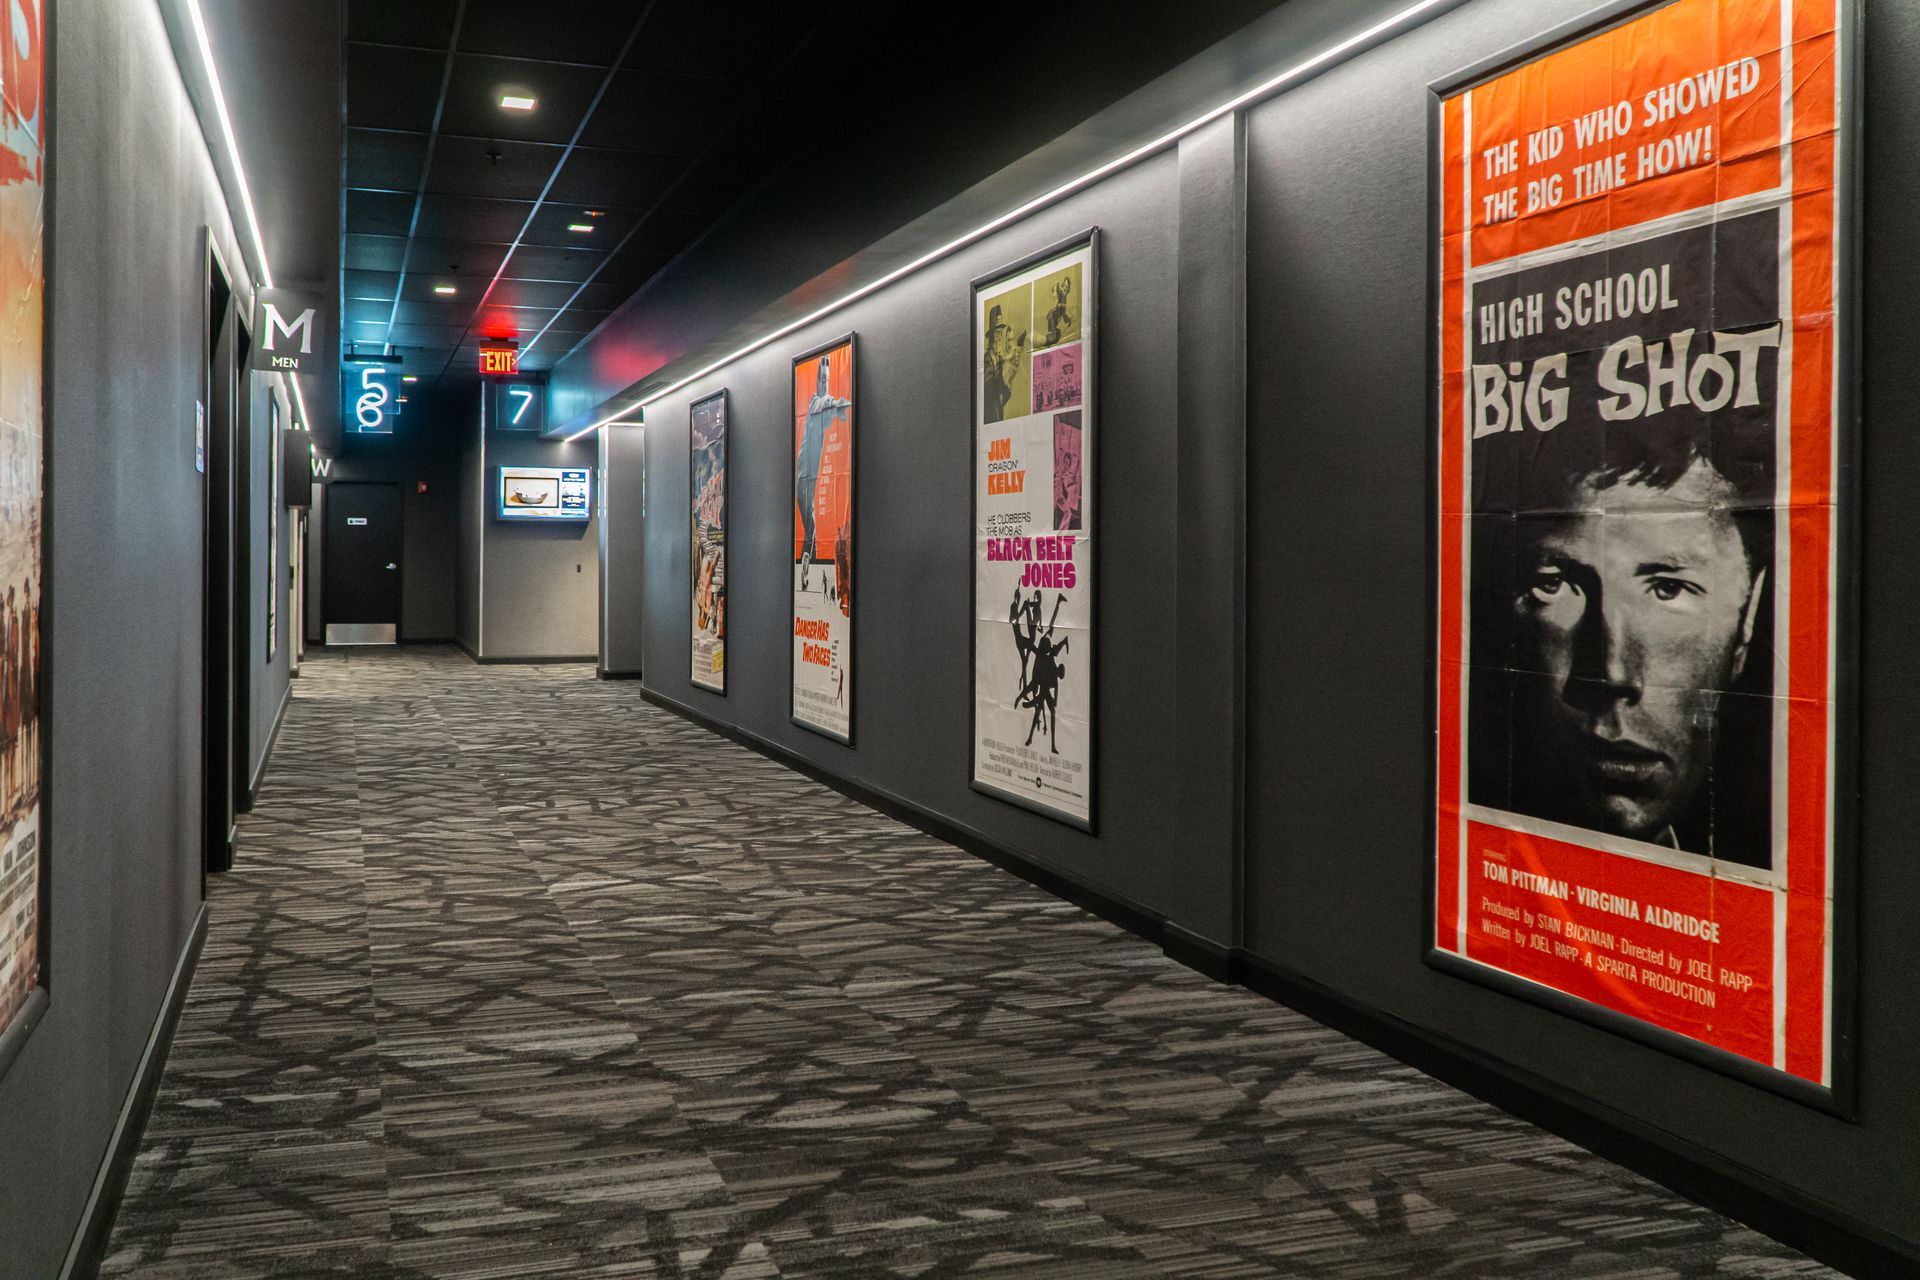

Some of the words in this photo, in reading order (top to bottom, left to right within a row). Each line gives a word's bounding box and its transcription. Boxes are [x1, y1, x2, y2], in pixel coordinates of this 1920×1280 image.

[1484, 140, 1518, 180] THE
[1528, 126, 1563, 166] KID
[1574, 101, 1632, 149] WHO
[1643, 56, 1760, 127] SHOWED
[1483, 186, 1518, 225] THE
[1528, 174, 1563, 213] BIG
[1573, 152, 1626, 199] TIME
[1638, 125, 1712, 181] HOW!
[1481, 293, 1543, 345] HIGH
[1556, 264, 1678, 330] SCHOOL
[262, 303, 316, 353] M
[272, 356, 298, 368] MEN
[486, 352, 513, 372] EXIT
[362, 368, 388, 407] 5
[356, 392, 382, 427] 6
[509, 390, 533, 424] 7
[988, 438, 1010, 461] JIM
[311, 458, 333, 477] W
[988, 470, 1025, 495] KELLY
[987, 527, 997, 536] THE
[999, 526, 1013, 536] MOB
[1014, 526, 1022, 535] AS
[988, 515, 996, 525] HE
[998, 512, 1031, 524] CLOBBERS
[988, 537, 1032, 561] BLACK
[1036, 536, 1075, 560] BELT
[1022, 563, 1076, 588] JONES
[1483, 861, 1508, 884] TOM
[1512, 869, 1568, 901] PITTMAN
[1576, 885, 1639, 920] VIRGINIA
[1645, 905, 1720, 944] ALDRIDGE
[1482, 896, 1519, 921] Produced
[1524, 909, 1534, 928] by
[1538, 914, 1561, 934] STAN
[1566, 921, 1614, 950] BICKMAN
[1621, 938, 1663, 966] Directed
[1669, 953, 1682, 974] by
[1688, 959, 1714, 982] JOEL
[1720, 968, 1752, 992] RAPP
[1482, 918, 1510, 941] Written
[1515, 929, 1526, 948] by
[1530, 934, 1552, 954] JOEL
[1555, 941, 1578, 962] RAPP
[1584, 952, 1592, 968] A
[1597, 955, 1637, 982] SPARTA
[1642, 969, 1715, 1008] PRODUCTION
